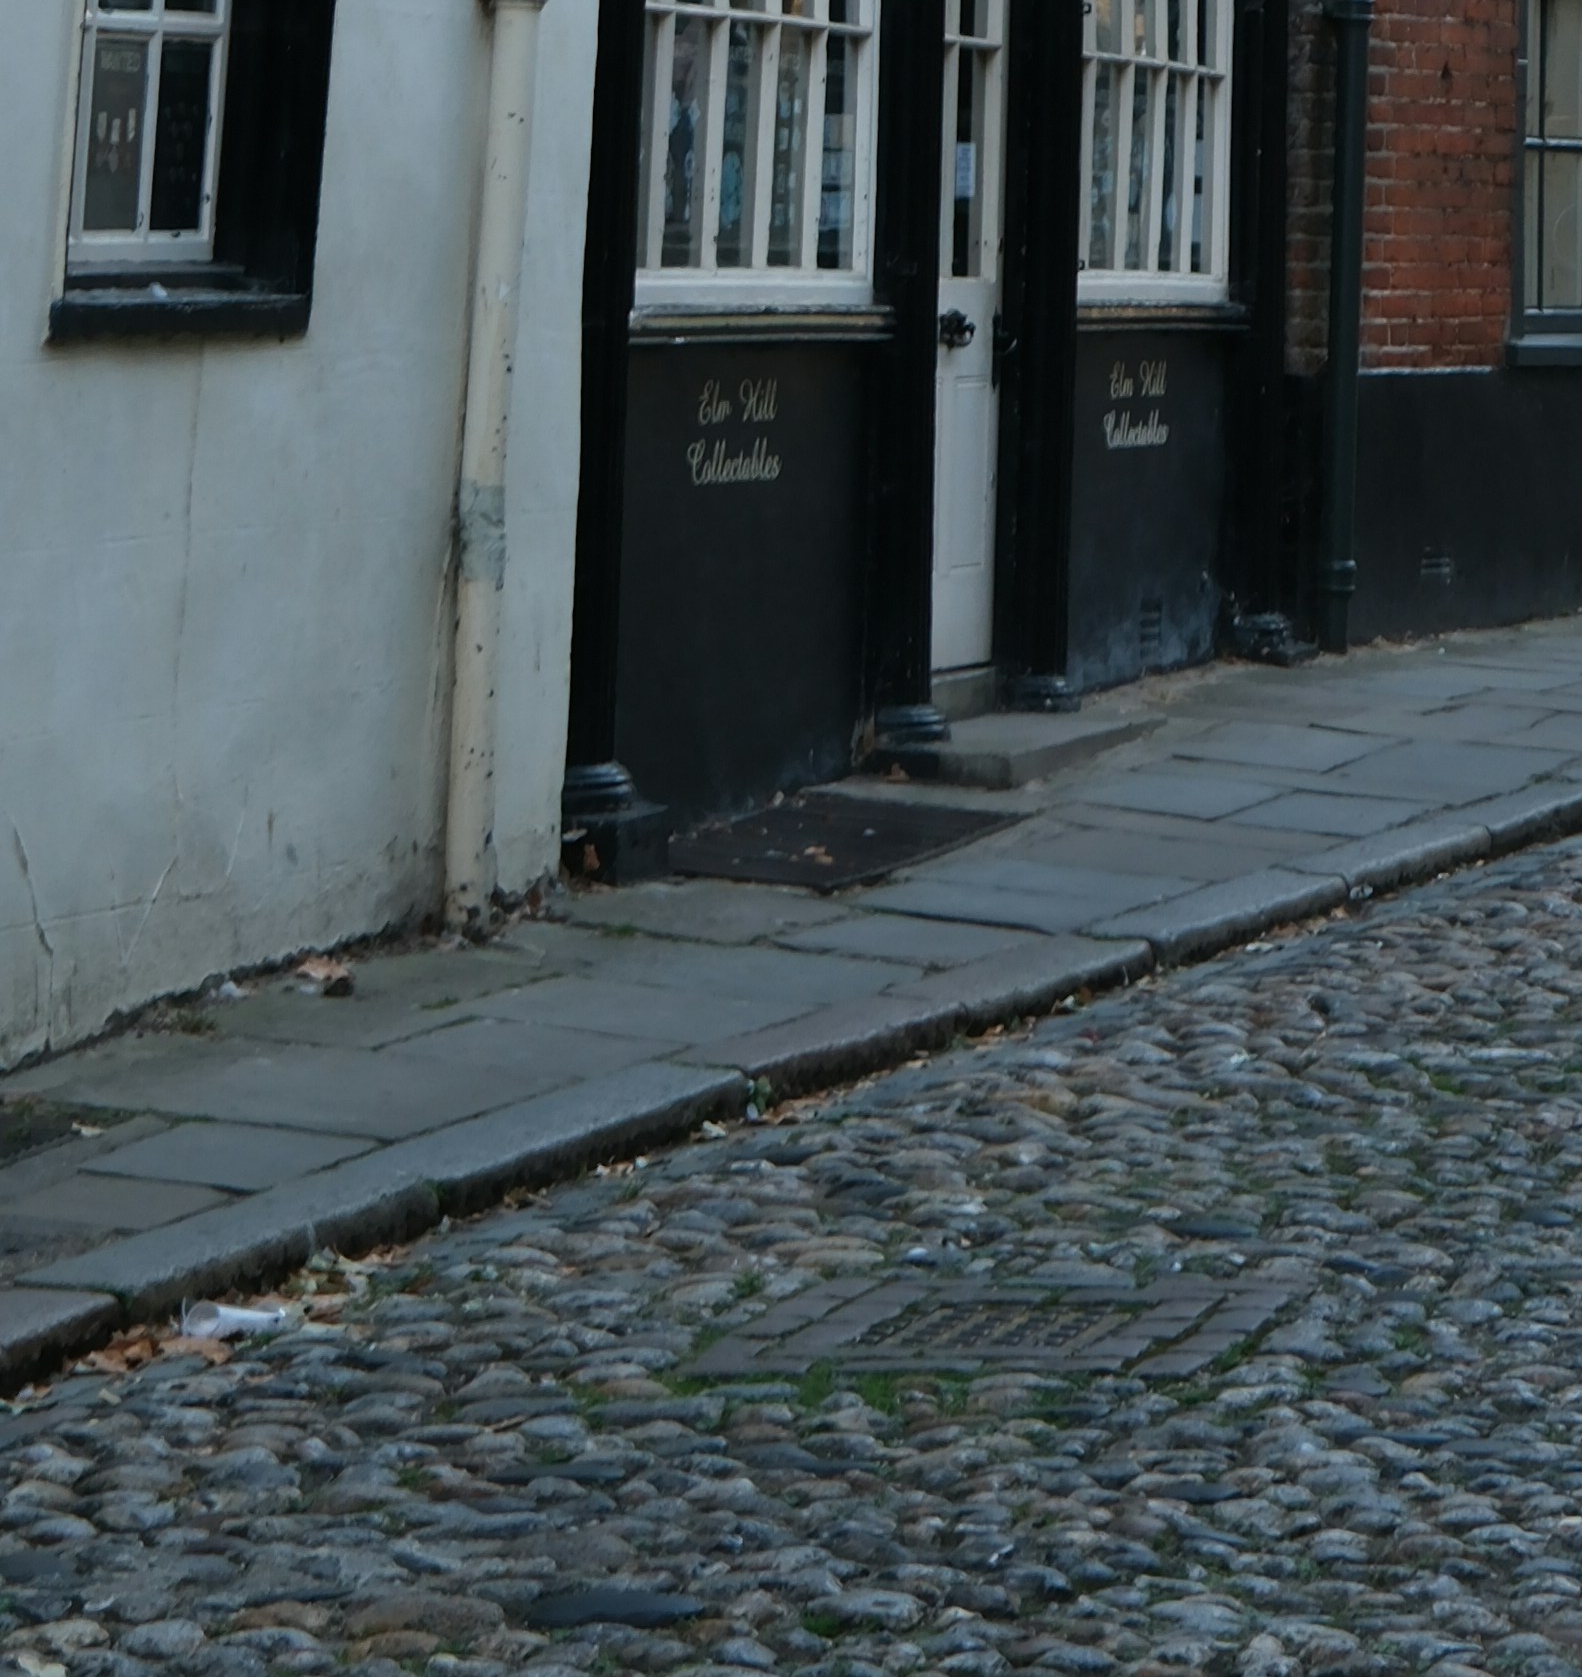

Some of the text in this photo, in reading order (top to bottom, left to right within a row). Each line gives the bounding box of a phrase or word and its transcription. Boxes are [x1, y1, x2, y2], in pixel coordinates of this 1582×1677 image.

[698, 377, 779, 426] Elm Hill
[1109, 359, 1167, 400] Elm Hill
[1103, 408, 1170, 450] Collectables
[686, 436, 783, 486] Collectables
